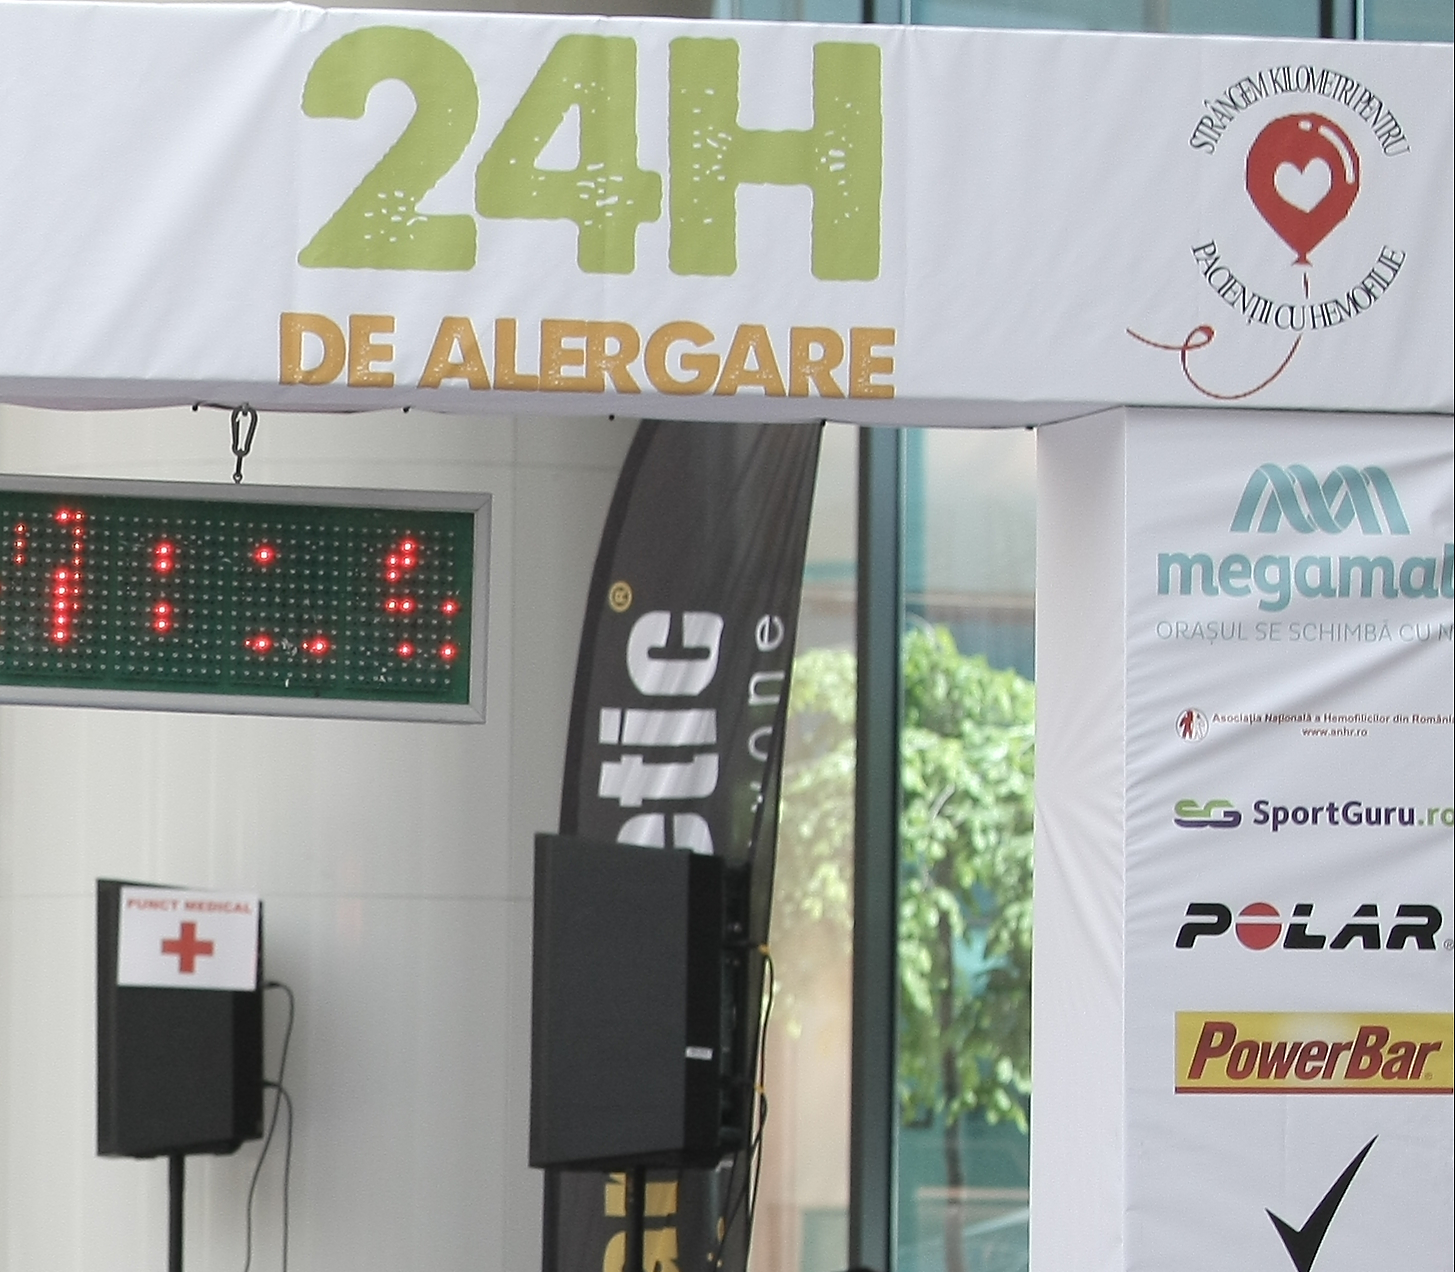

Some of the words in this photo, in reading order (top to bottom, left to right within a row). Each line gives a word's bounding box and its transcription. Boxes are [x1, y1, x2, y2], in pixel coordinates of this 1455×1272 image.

[1189, 71, 1272, 155] STRÂNGEM
[1269, 65, 1358, 106] KILOMETRI
[1355, 87, 1411, 157] PENTRU
[297, 25, 883, 281] 24H
[1274, 304, 1306, 332] CU
[1310, 245, 1407, 330] HEMOFILIE
[278, 312, 395, 388] DE
[418, 315, 897, 399] ALERGARE
[1256, 621, 1281, 642] SE
[1288, 616, 1392, 643] SCHIMBĂ
[1399, 622, 1431, 642] CU
[1301, 727, 1368, 738] www.anhr.ro
[1323, 713, 1390, 725] Hemofilicilor
[1393, 713, 1409, 725] din
[1252, 800, 1453, 832] SportGuru.ro
[184, 901, 252, 915] MEDICAL
[1175, 902, 1443, 951] POLAR
[1187, 1020, 1443, 1081] PowerBar
